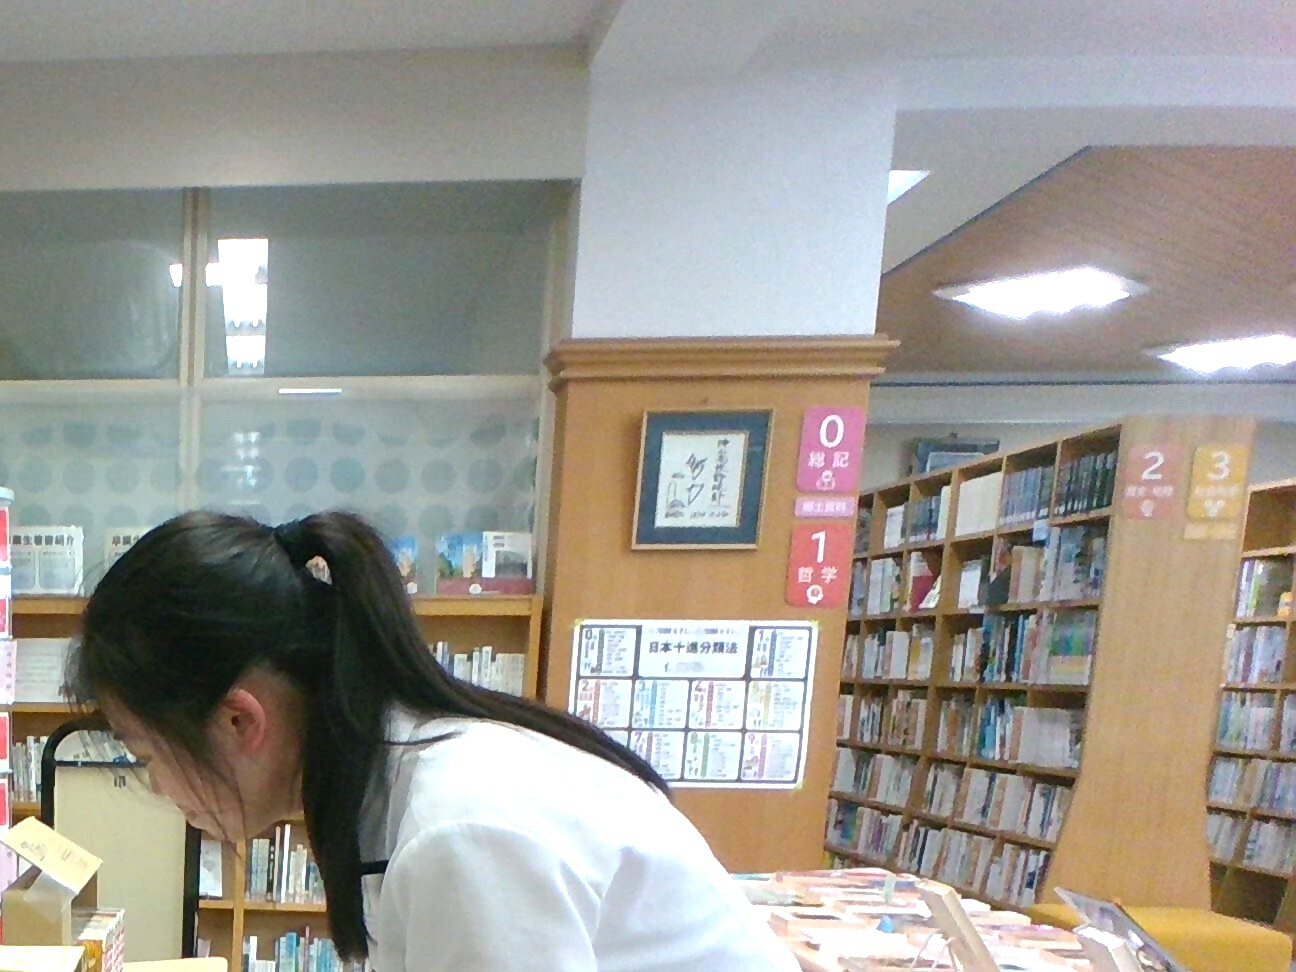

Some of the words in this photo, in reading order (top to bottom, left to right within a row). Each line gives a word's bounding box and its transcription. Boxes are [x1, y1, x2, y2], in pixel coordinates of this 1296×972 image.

[819, 414, 845, 448] 0
[1141, 451, 1164, 480] 2
[1207, 450, 1232, 480] 3
[811, 530, 826, 563] 1
[798, 566, 839, 584] 哲学
[649, 640, 738, 654] 日本十進分類法
